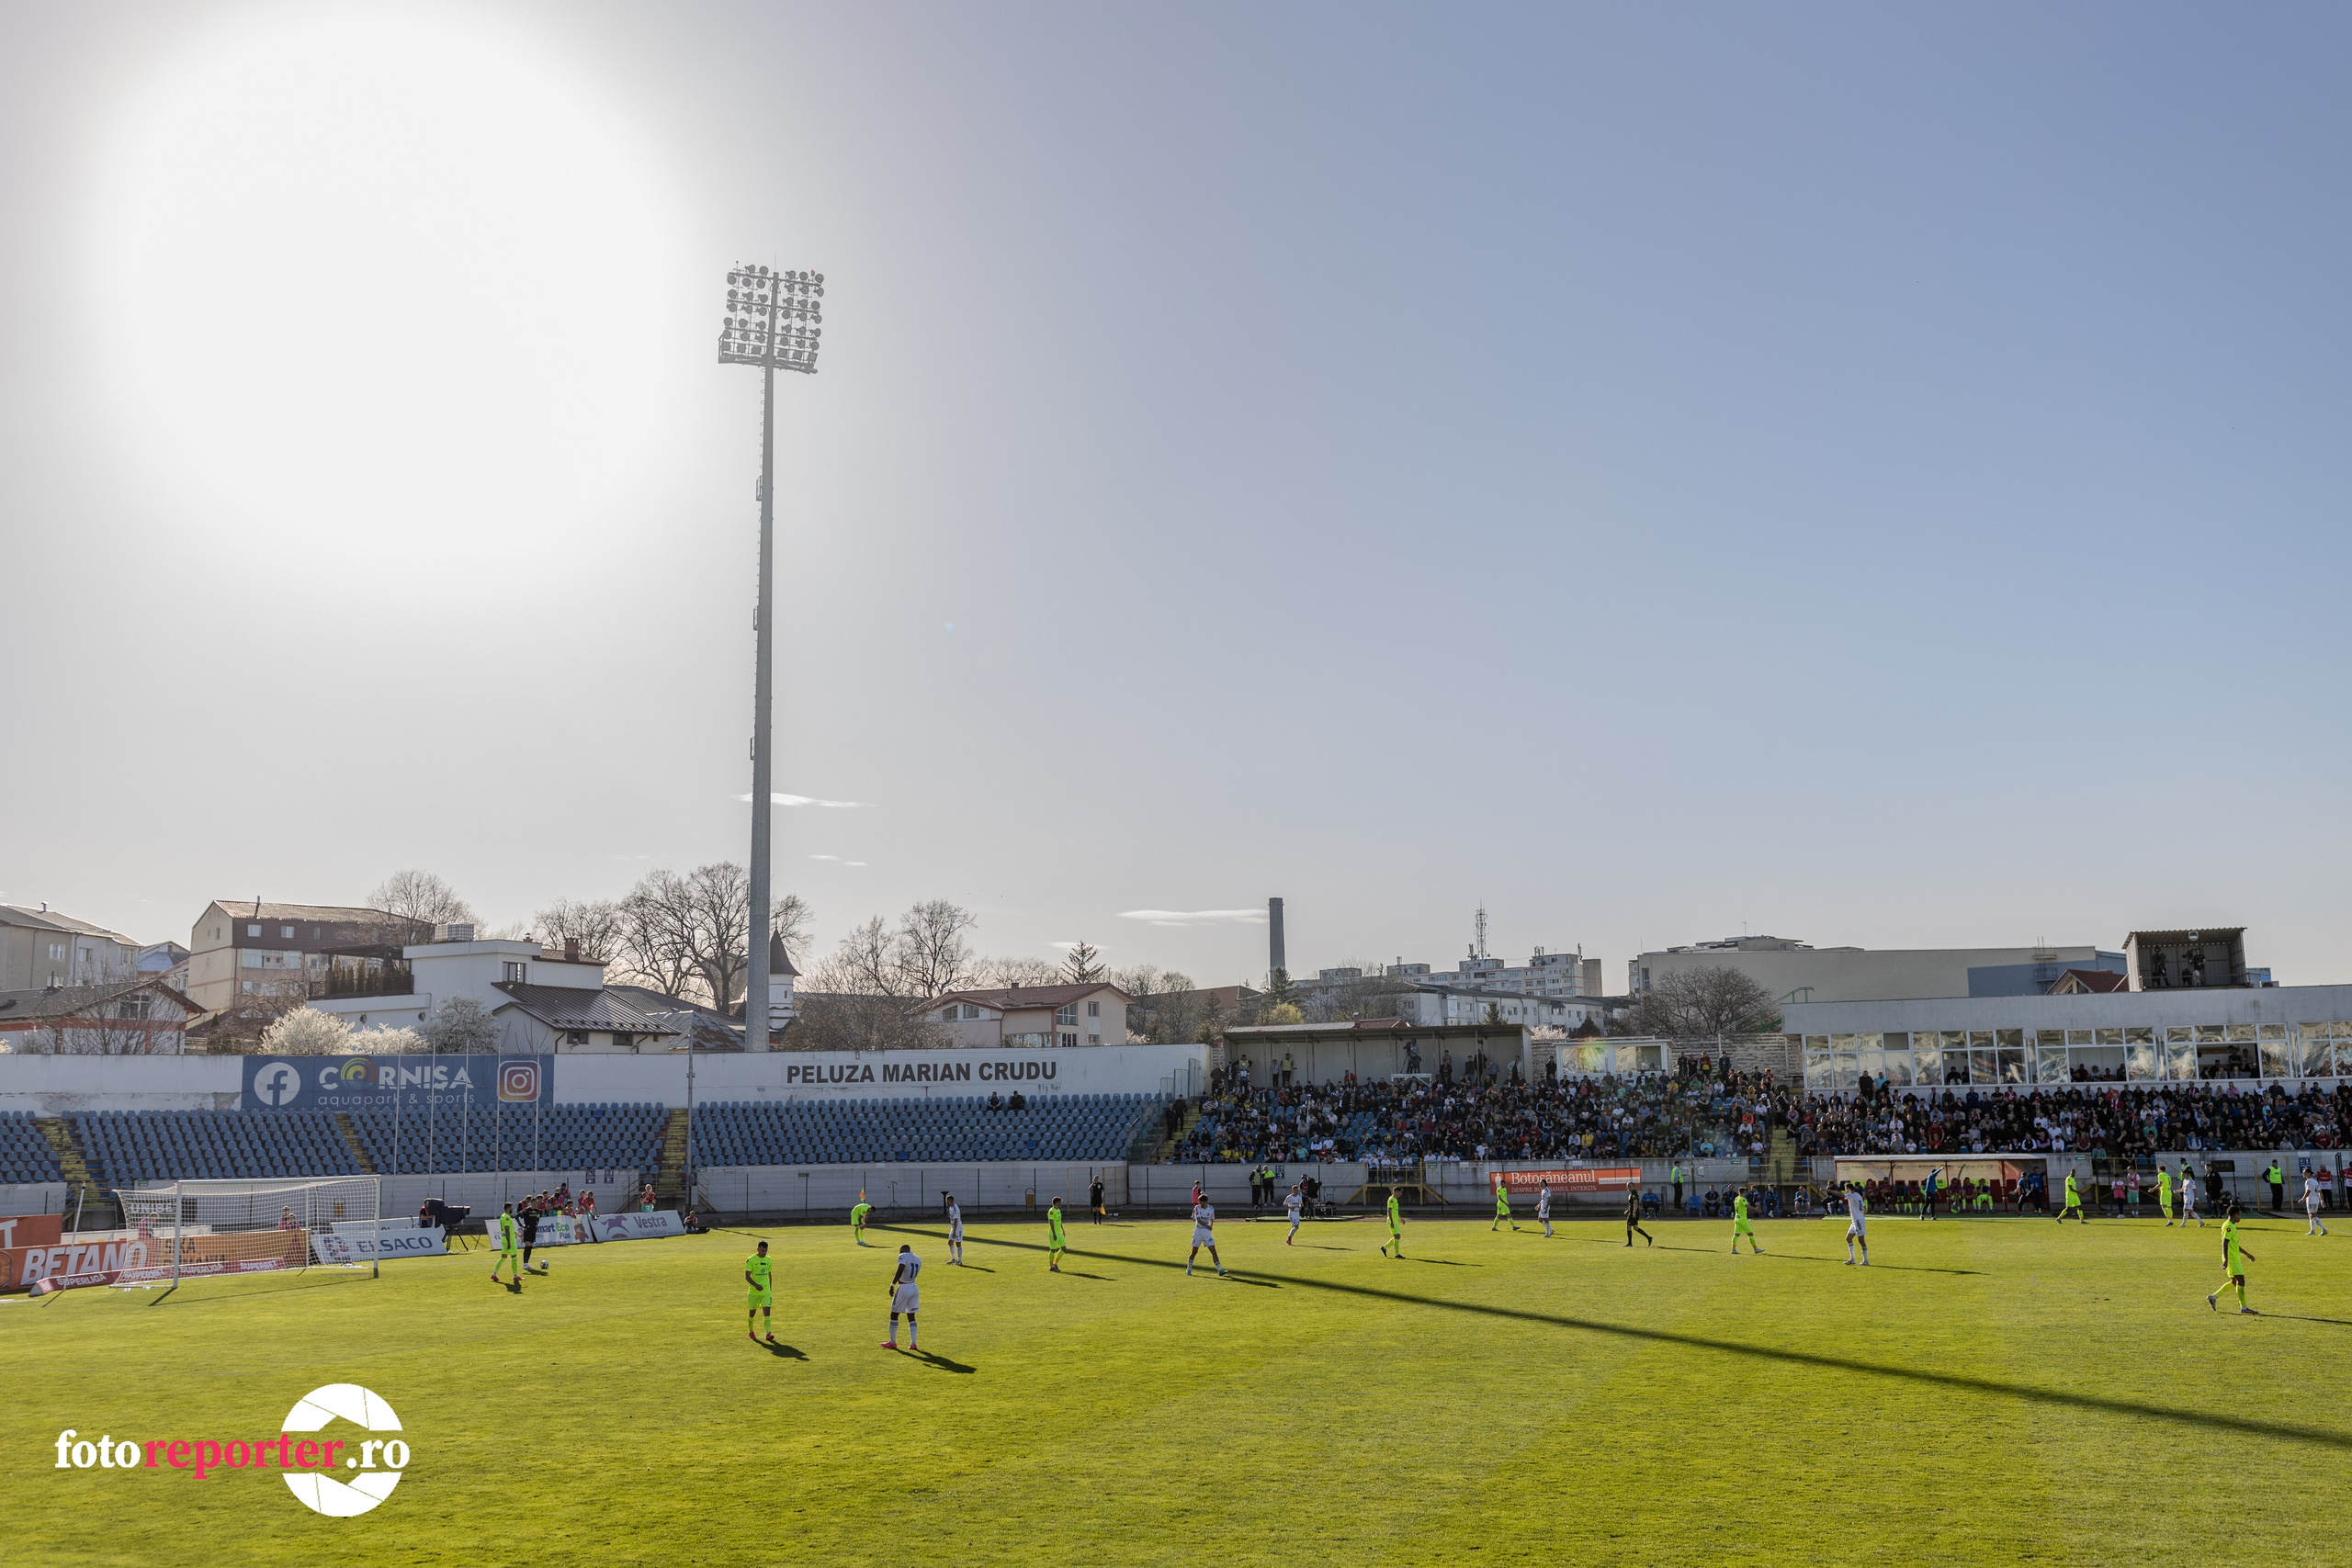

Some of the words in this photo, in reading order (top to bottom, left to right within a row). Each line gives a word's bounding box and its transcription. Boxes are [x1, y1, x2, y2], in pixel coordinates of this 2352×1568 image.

[786, 1064, 876, 1084] PELUZA
[882, 1063, 971, 1083] MARIAN
[978, 1061, 1057, 1081] CRUDU
[318, 1092, 400, 1107] aquapark
[409, 1093, 418, 1104] &
[426, 1090, 475, 1106] sports
[536, 1223, 555, 1234] mart
[556, 1222, 569, 1232] Eco
[633, 1215, 668, 1228] Vestra
[356, 1236, 433, 1253] ELSACO
[20, 1241, 148, 1286] BETANO
[180, 1263, 224, 1274] SUPERLIGA
[240, 1258, 277, 1270] SUPERBET
[123, 1267, 164, 1279] SUPERBET
[910, 1262, 919, 1280] 11
[56, 1273, 107, 1286] SUPERLIGA
